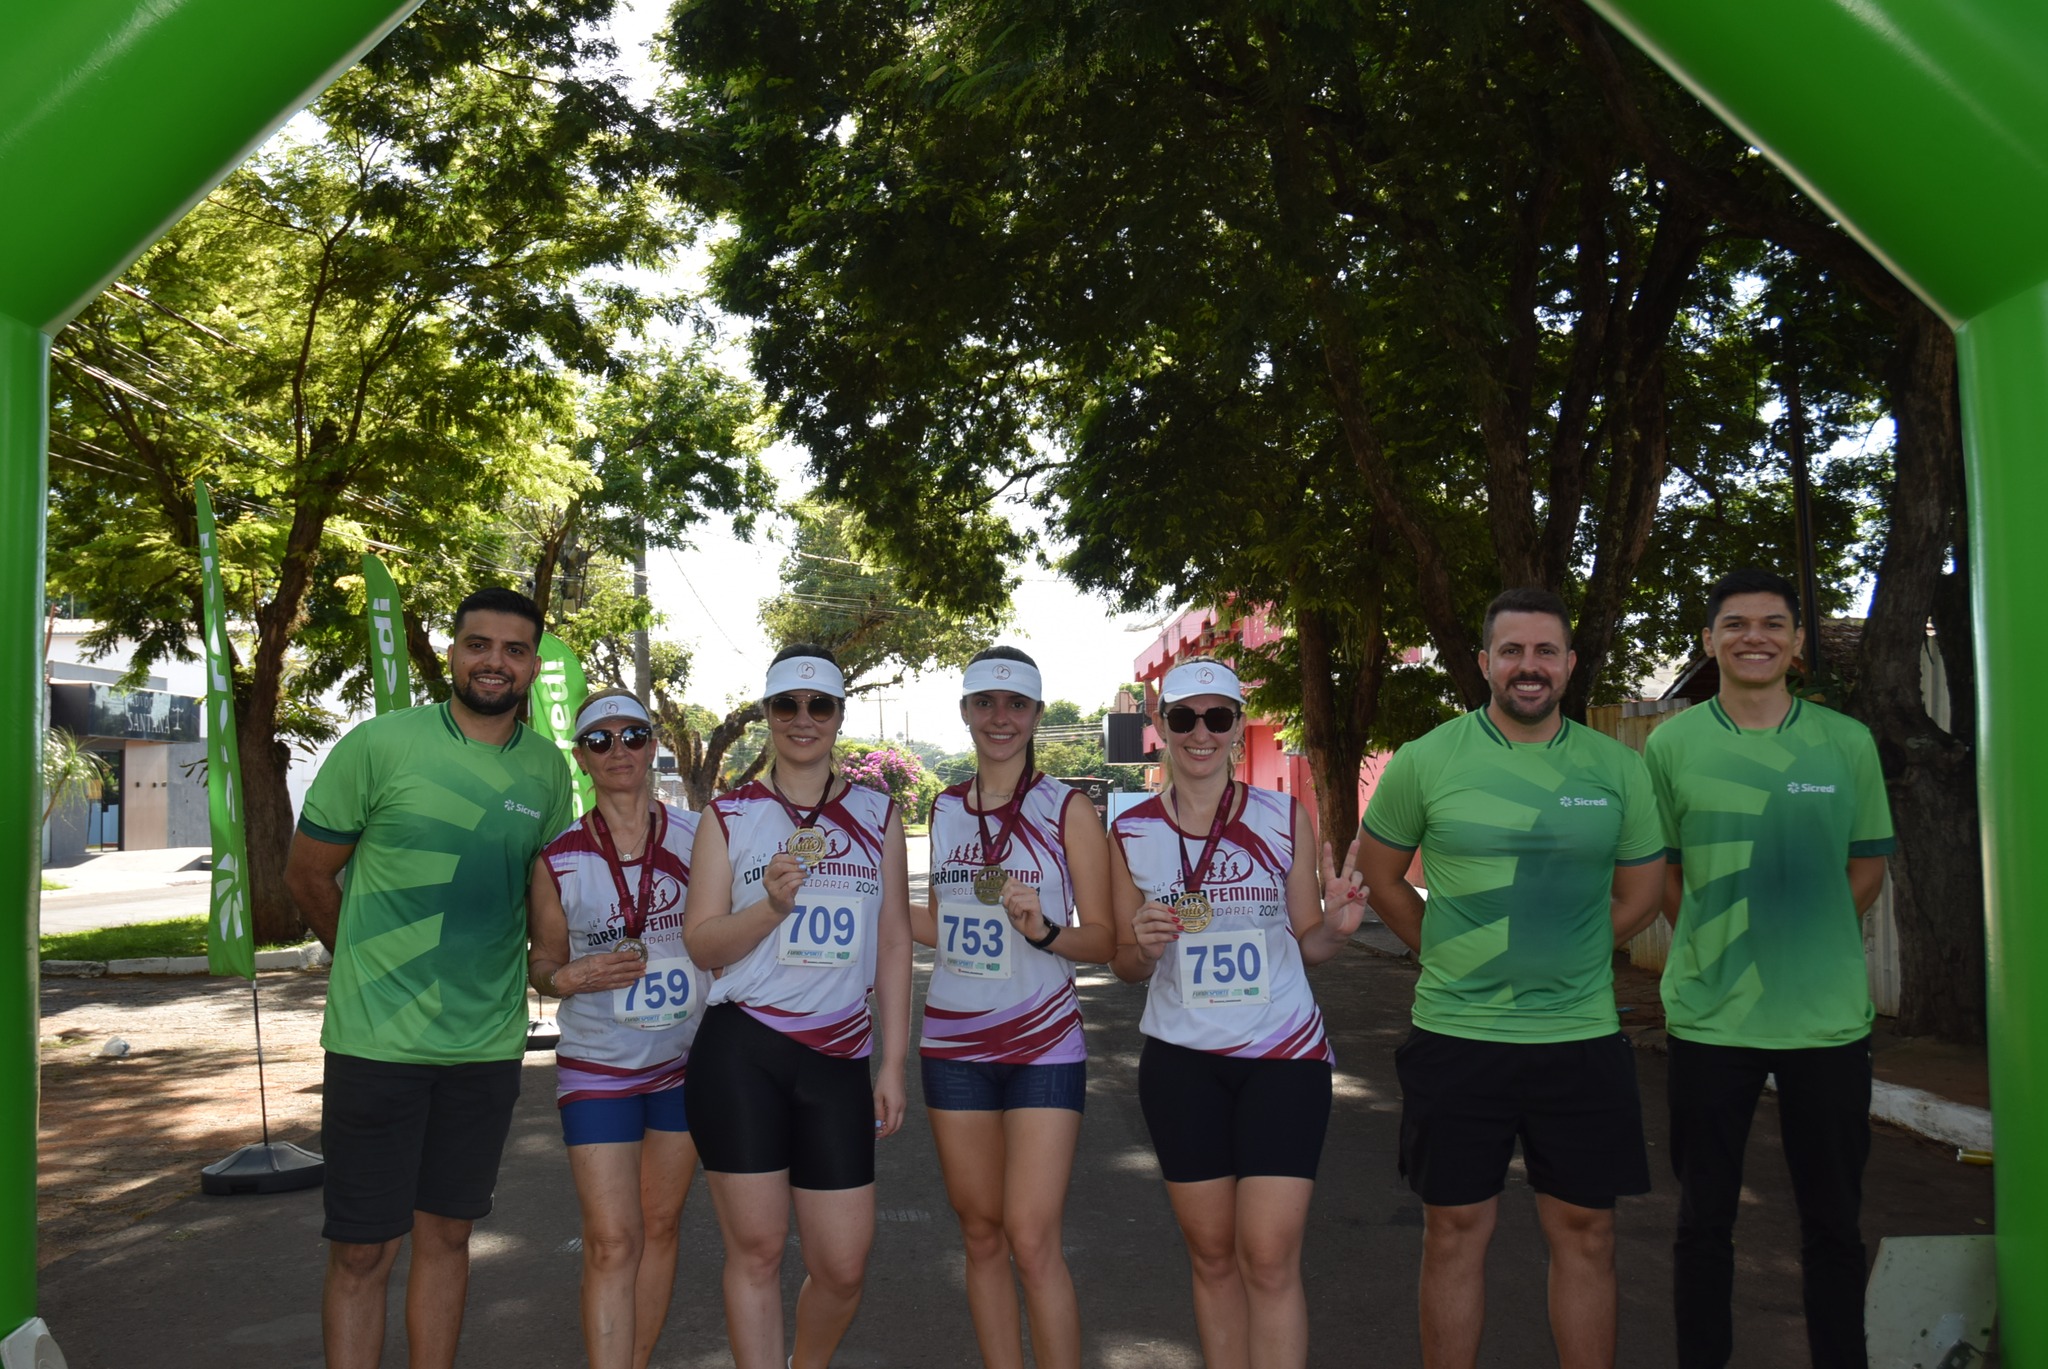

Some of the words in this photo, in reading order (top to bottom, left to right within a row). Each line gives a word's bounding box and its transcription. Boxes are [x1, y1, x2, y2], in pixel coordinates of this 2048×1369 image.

[1574, 797, 1608, 806] Sicredi
[1800, 783, 1835, 793] Sicredi
[1210, 887, 1279, 903] FEMININA
[789, 905, 855, 946] 709
[943, 914, 1004, 958] 753
[1186, 942, 1261, 984] 750
[625, 968, 690, 1012] 759
